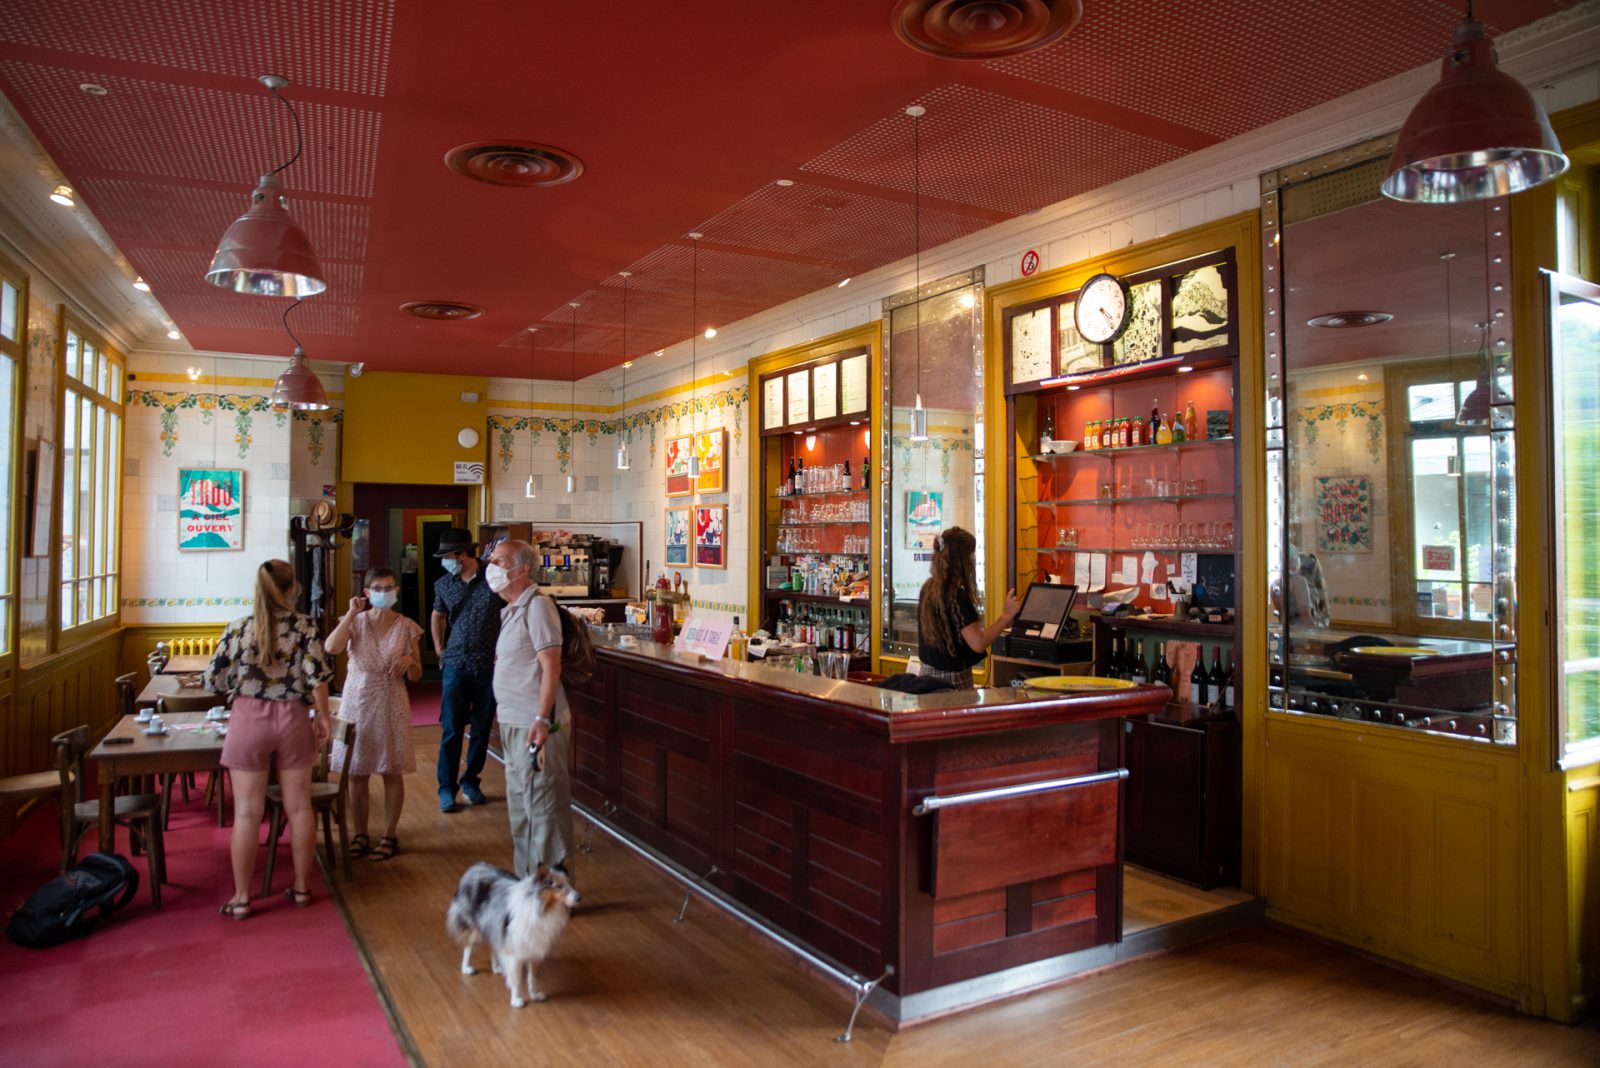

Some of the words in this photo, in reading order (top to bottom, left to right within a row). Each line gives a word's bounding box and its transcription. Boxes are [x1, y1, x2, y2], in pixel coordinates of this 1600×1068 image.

[1113, 289, 1120, 298] 2
[1117, 300, 1123, 308] 3
[190, 479, 232, 506] TROU
[203, 513, 230, 521] CIEL
[187, 524, 234, 532] OUVERT
